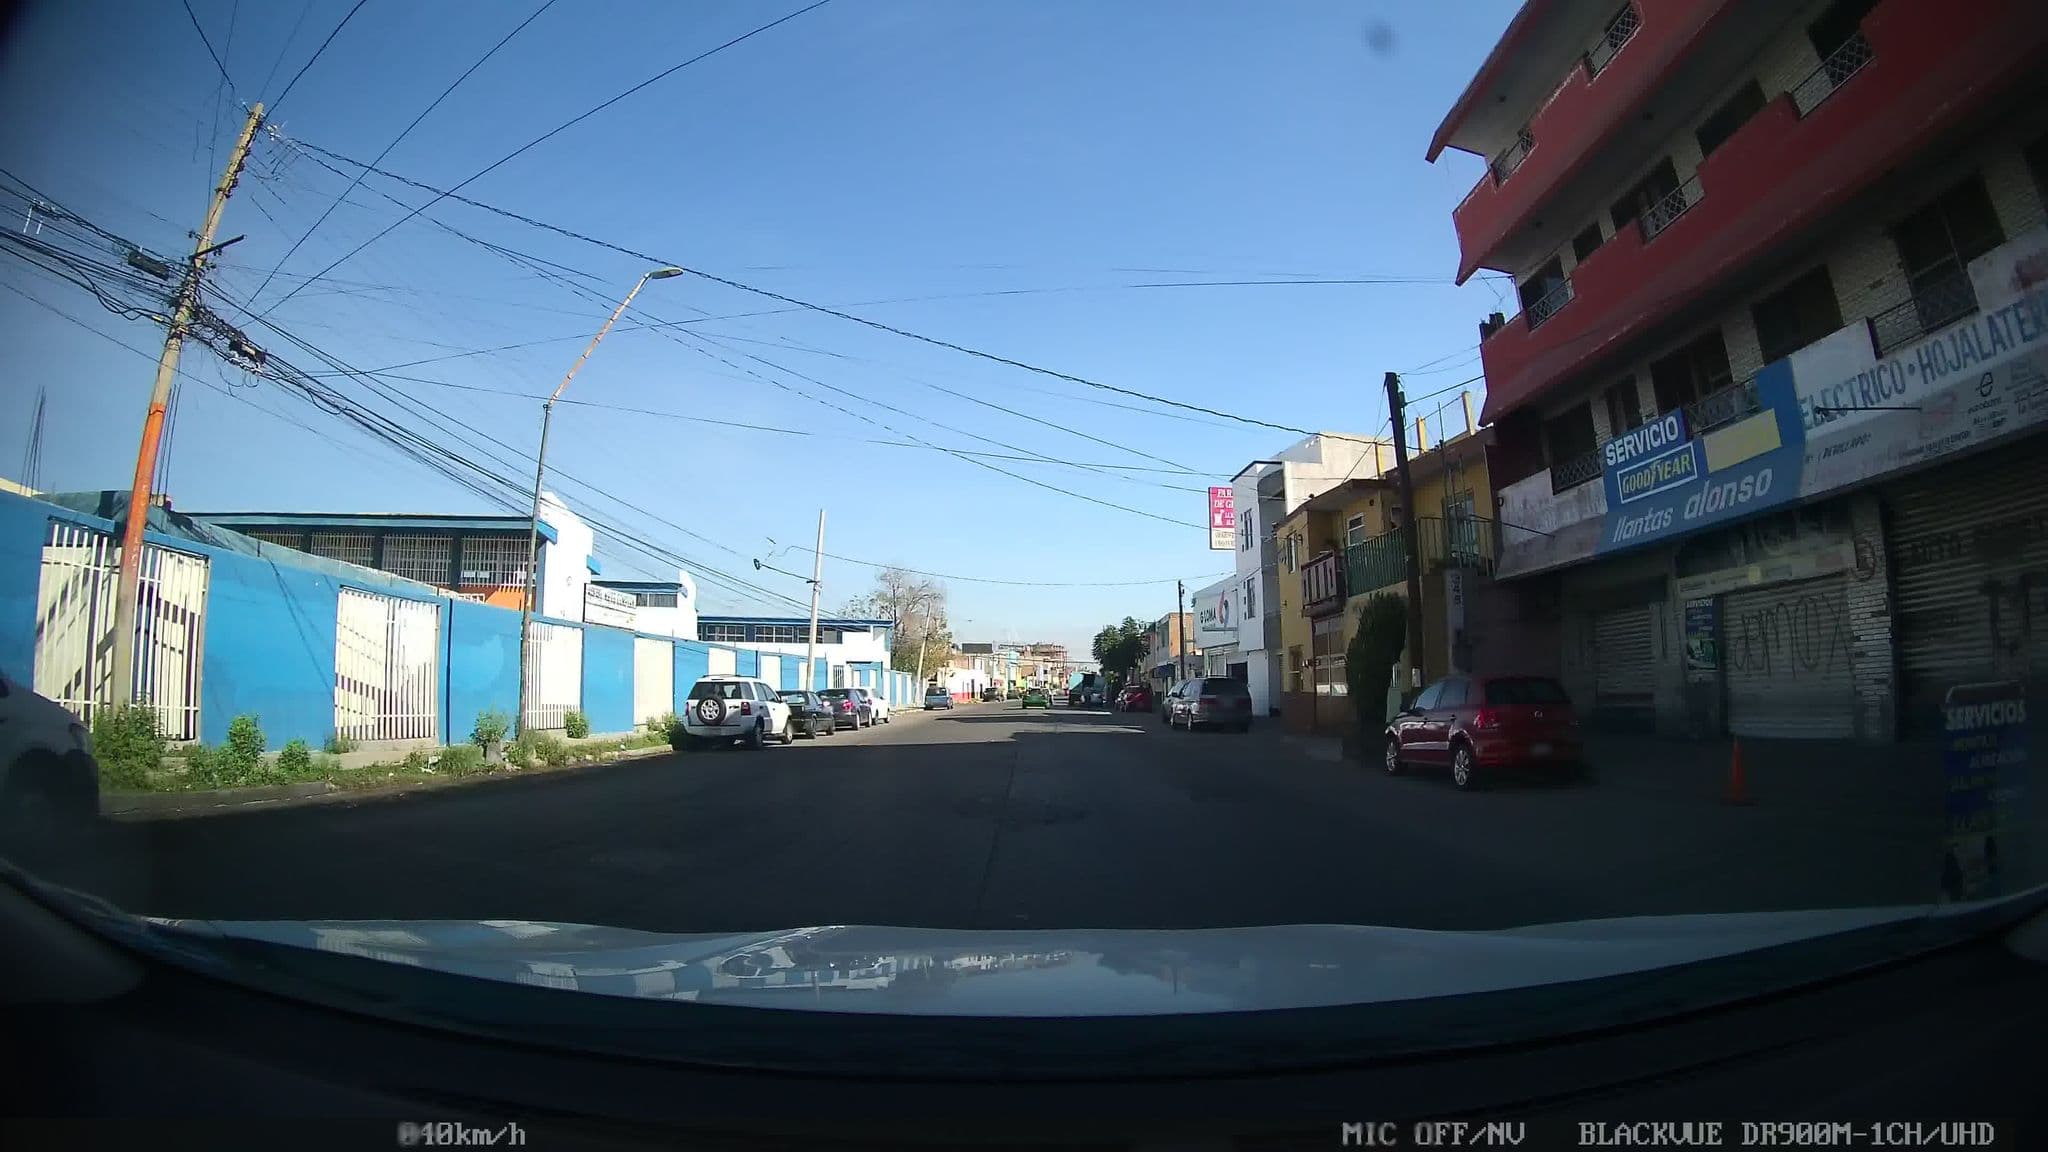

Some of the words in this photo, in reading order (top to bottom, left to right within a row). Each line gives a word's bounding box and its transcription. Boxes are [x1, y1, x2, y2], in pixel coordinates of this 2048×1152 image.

[1800, 359, 1905, 431] ELECTRICO
[1605, 415, 1679, 467] SERVICIO
[1622, 453, 1691, 495] GOODYEAR
[1613, 507, 1674, 543] llantas
[1684, 468, 1773, 520] alonso
[1945, 699, 2027, 731] SERVICIOS
